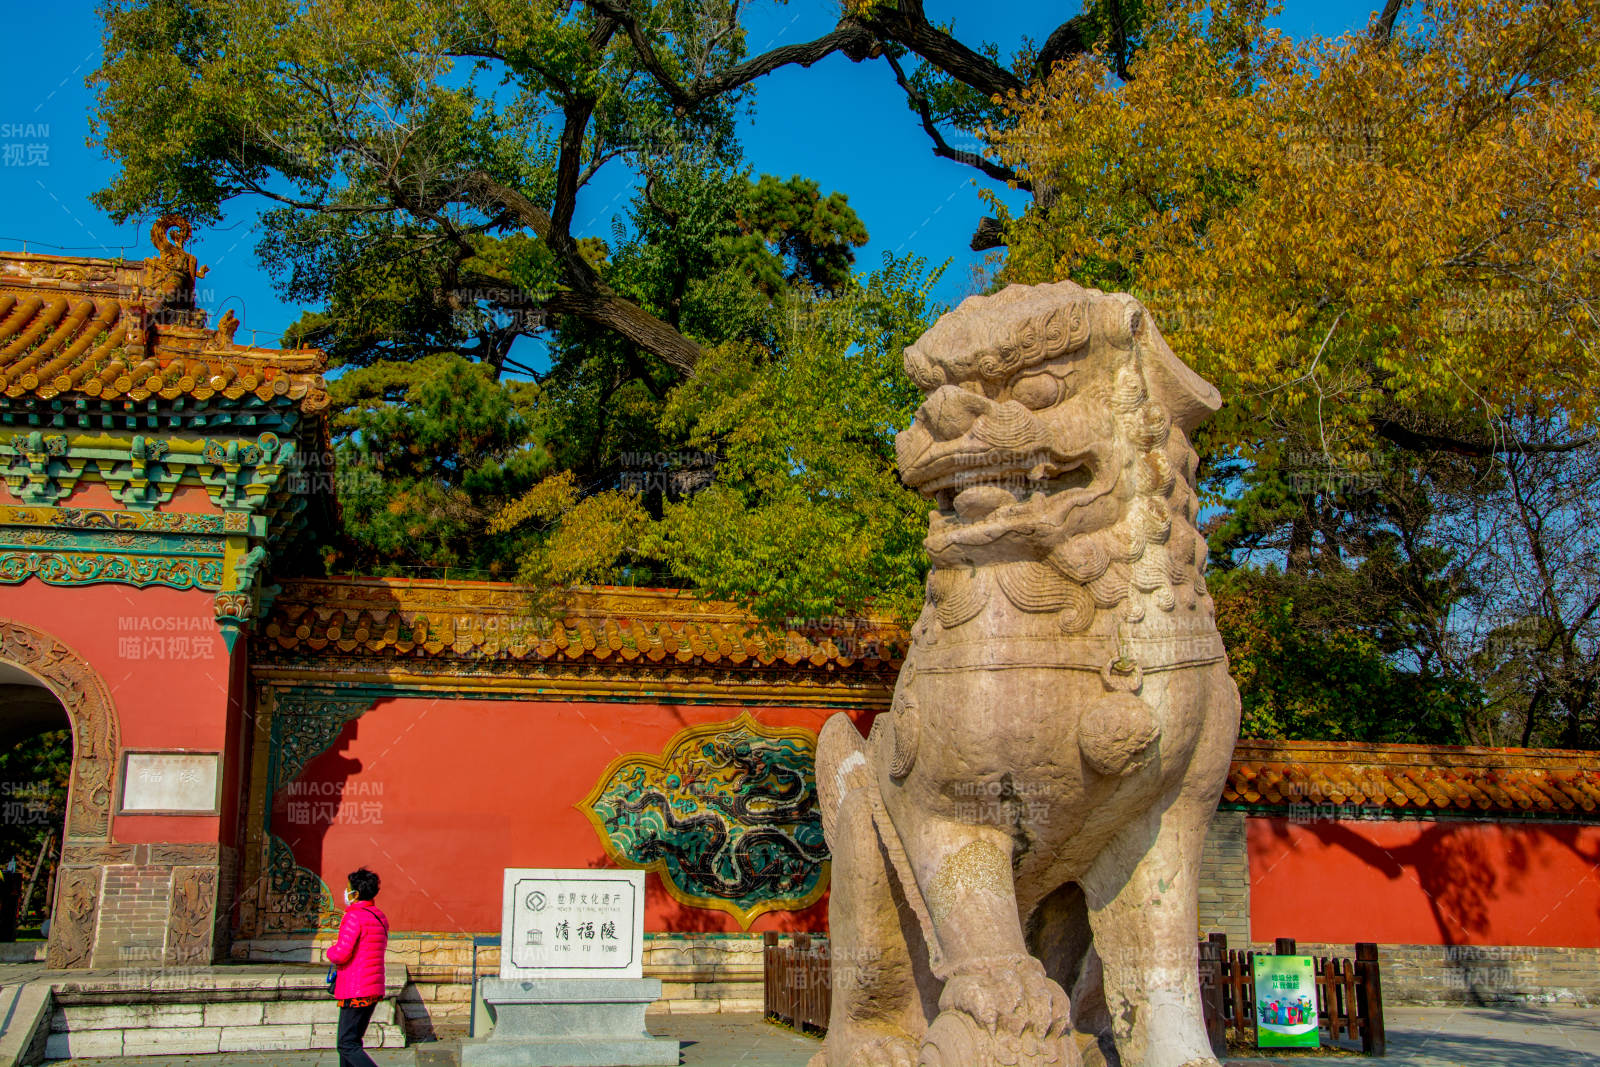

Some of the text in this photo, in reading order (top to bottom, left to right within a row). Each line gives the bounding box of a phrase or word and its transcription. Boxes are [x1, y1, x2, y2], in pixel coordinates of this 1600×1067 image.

[557, 893, 621, 905] 世界文化遗产
[555, 920, 620, 940] 清福陵
